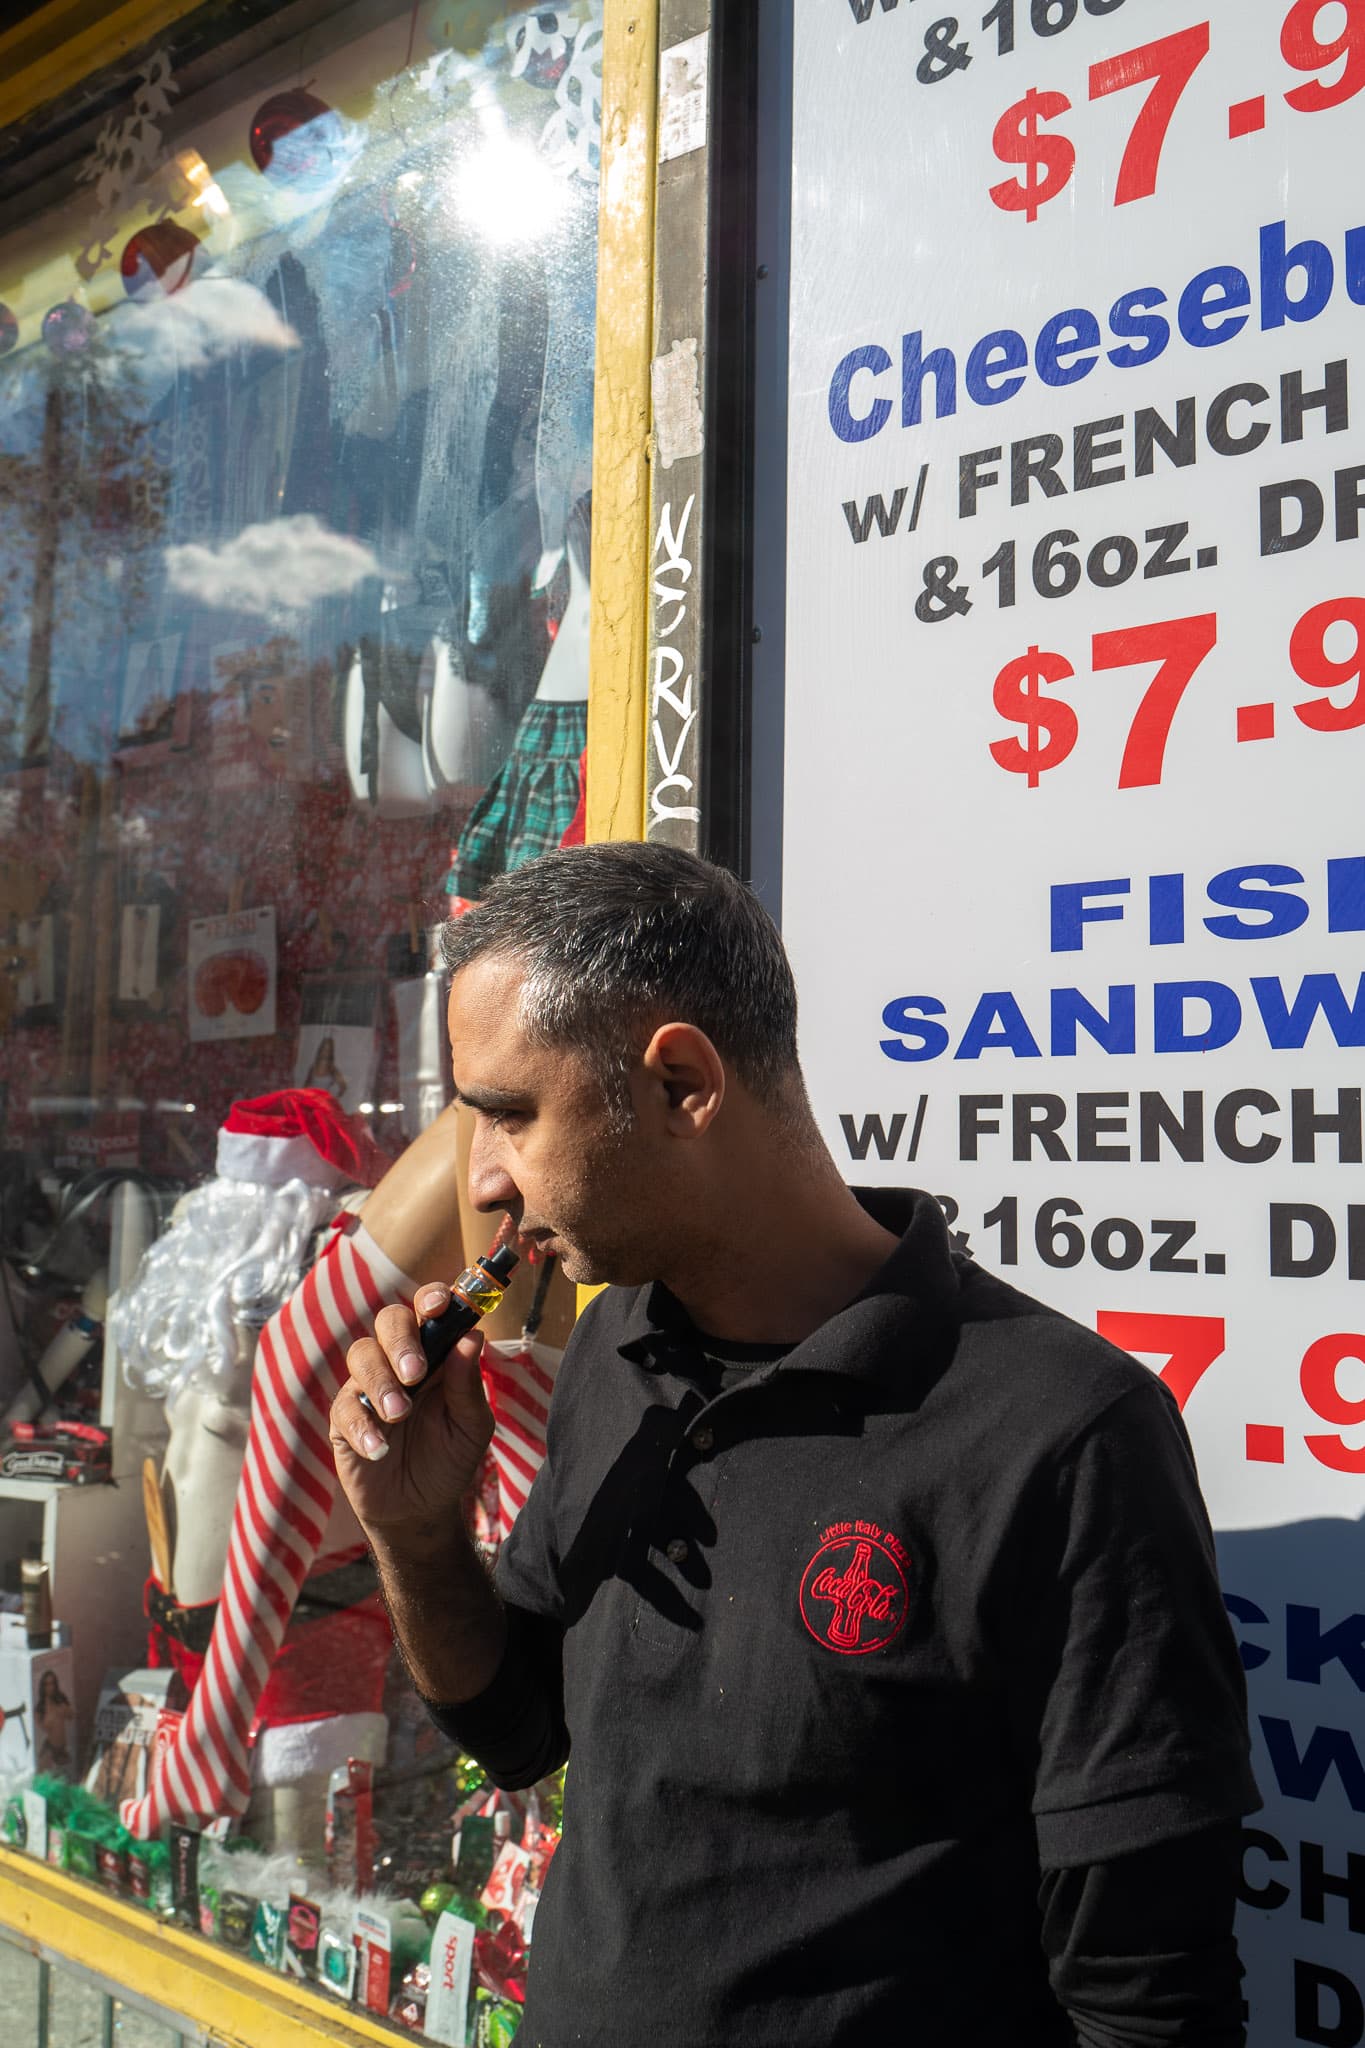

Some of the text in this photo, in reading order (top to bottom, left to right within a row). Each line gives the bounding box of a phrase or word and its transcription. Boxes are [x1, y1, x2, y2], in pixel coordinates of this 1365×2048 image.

[841, 358, 1349, 545] w/ FRENCH
[914, 521, 1219, 623] &16oz.
[988, 596, 1365, 789] $7.9
[879, 971, 1365, 1063] SANDW
[838, 1087, 1363, 1164] w/ FRENCH
[1269, 1202, 1365, 1281] D
[819, 1522, 852, 1543] Little
[855, 1519, 884, 1538] Italy
